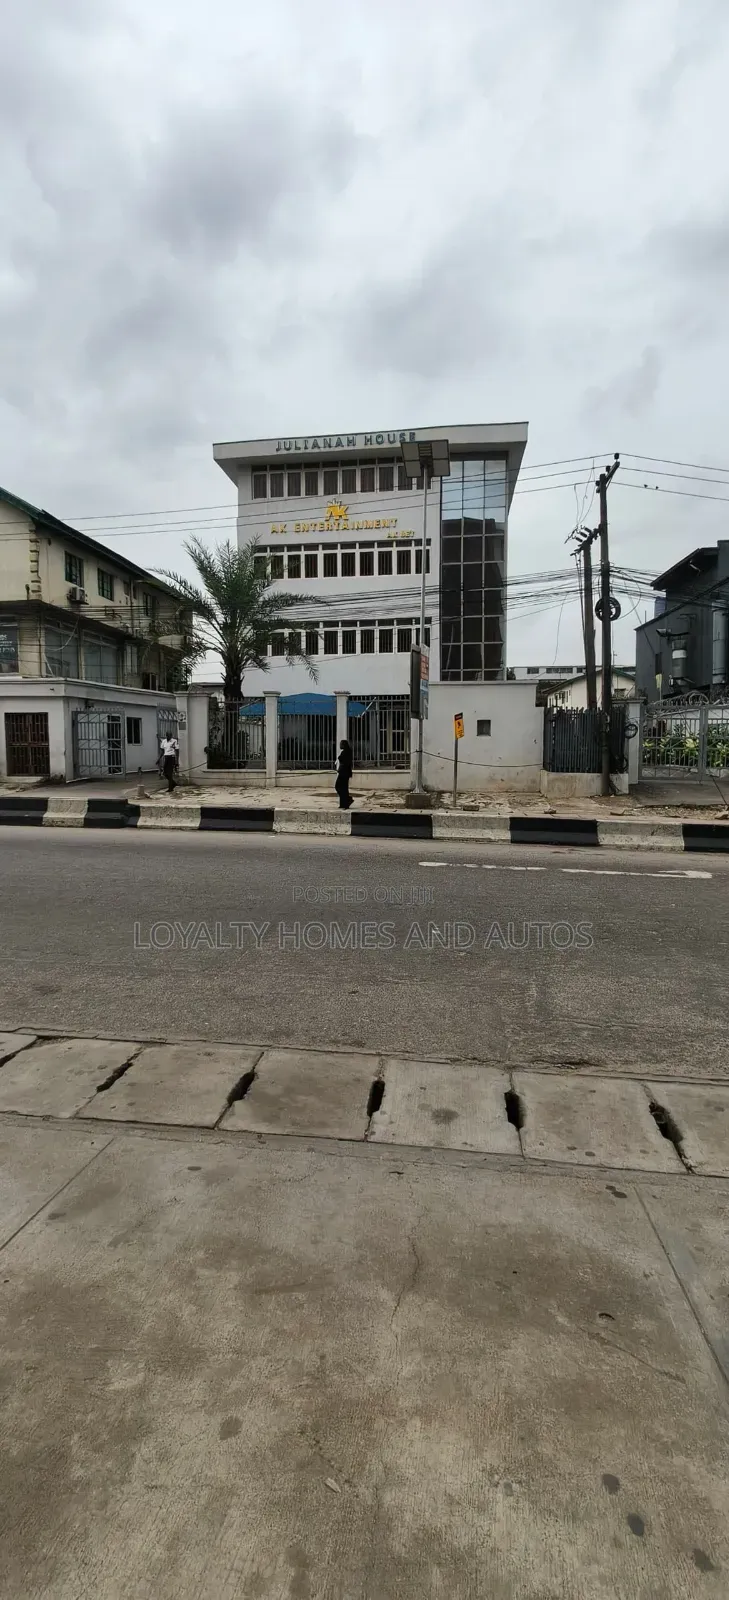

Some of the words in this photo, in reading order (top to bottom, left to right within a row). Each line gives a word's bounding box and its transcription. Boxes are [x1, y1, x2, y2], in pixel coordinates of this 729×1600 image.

[275, 436, 357, 452] JULIANAH
[364, 432, 416, 446] HOUSE
[270, 523, 287, 534] AK
[294, 518, 398, 533] ENTERTAINMENT
